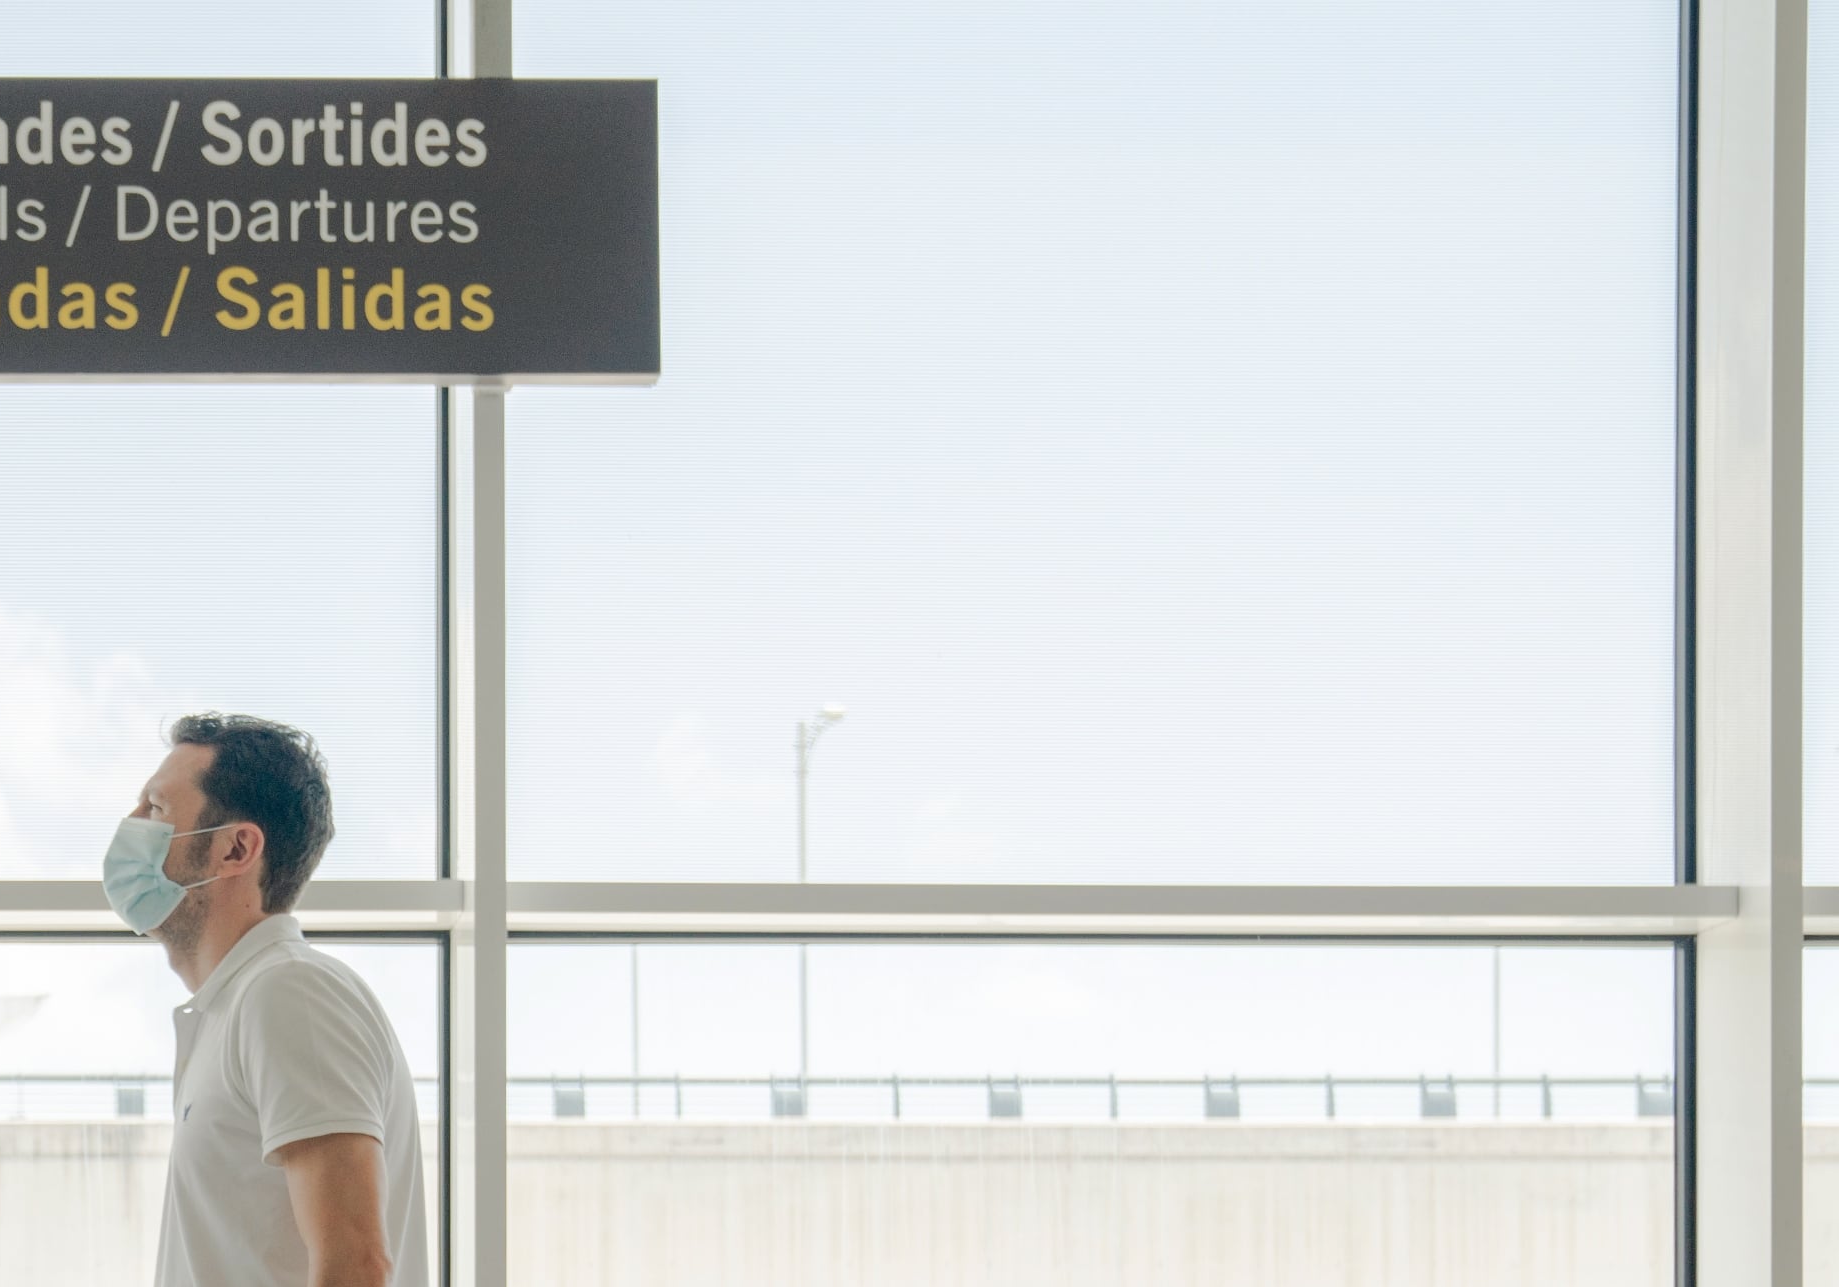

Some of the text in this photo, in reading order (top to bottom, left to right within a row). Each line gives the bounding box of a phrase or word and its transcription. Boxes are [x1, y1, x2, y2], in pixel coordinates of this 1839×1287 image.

[151, 100, 180, 172] /
[200, 100, 488, 168] Sortides
[65, 185, 92, 248] /
[117, 185, 480, 255] Departures
[161, 266, 190, 337] /
[215, 266, 495, 332] Salidas
